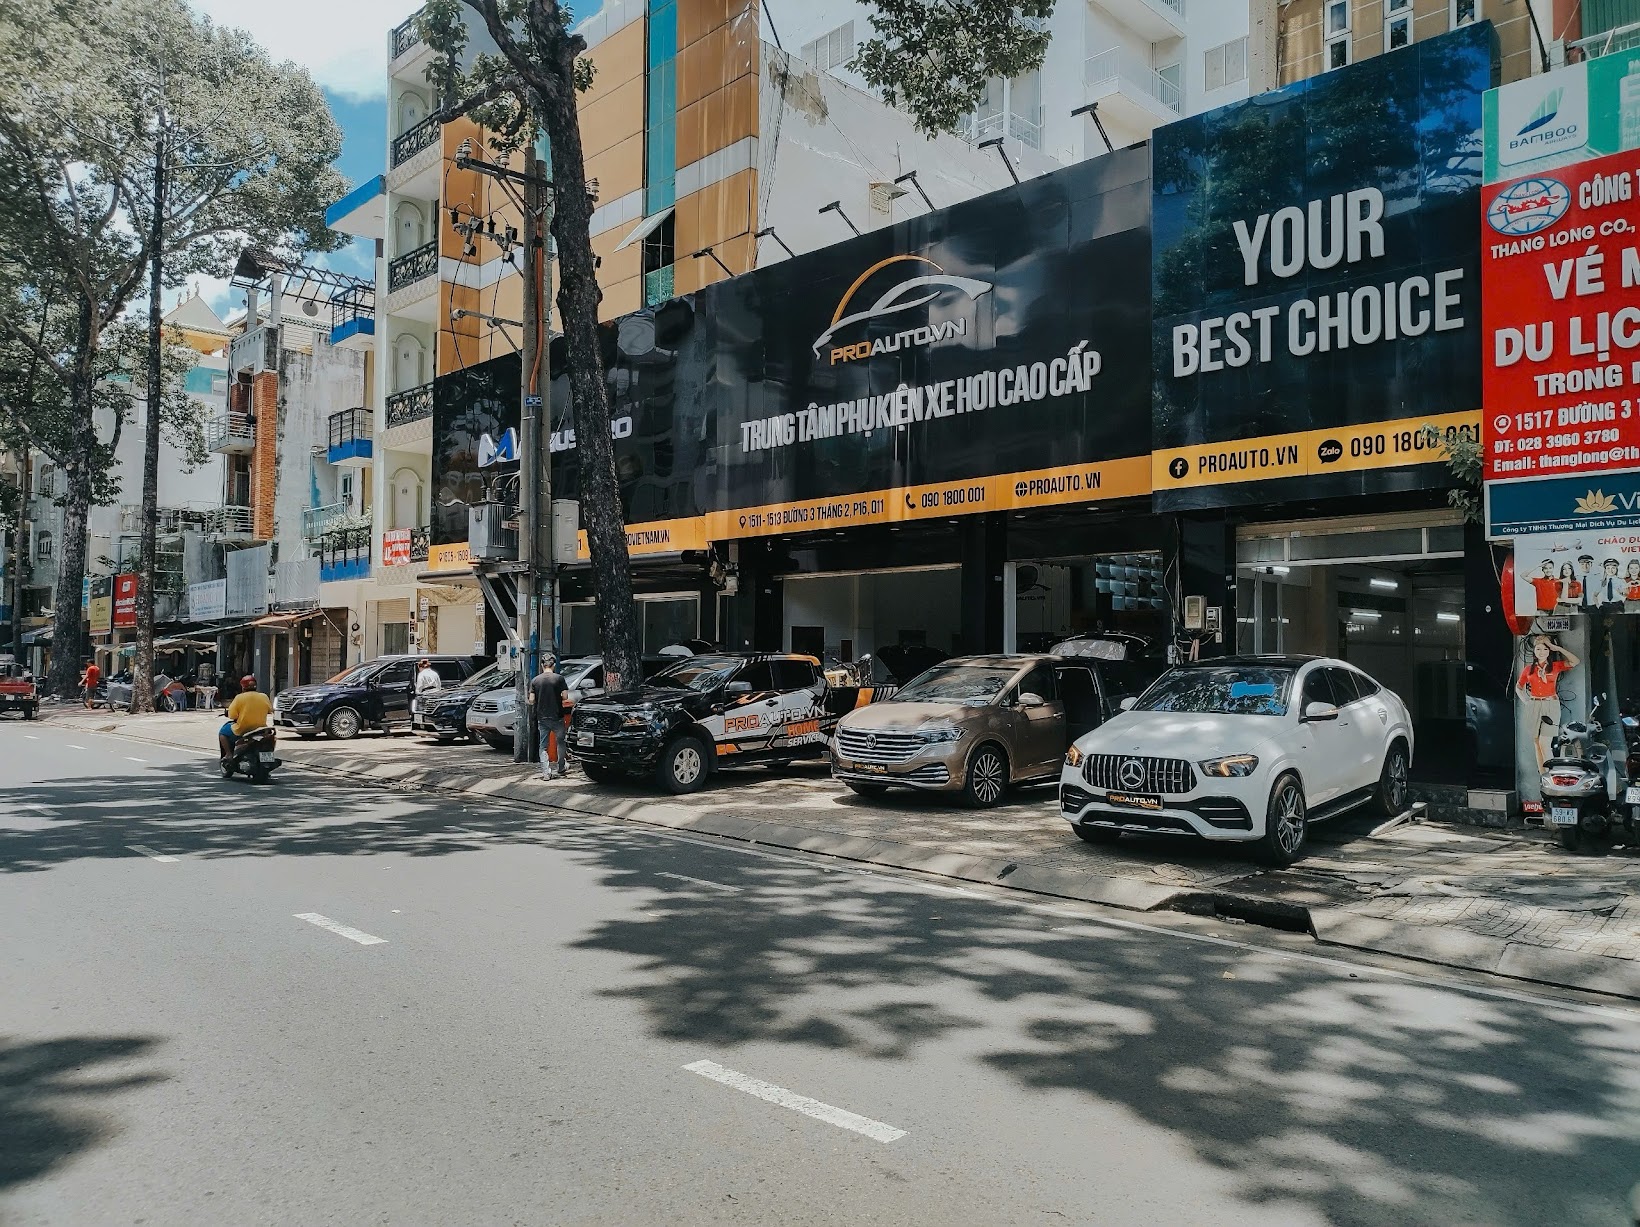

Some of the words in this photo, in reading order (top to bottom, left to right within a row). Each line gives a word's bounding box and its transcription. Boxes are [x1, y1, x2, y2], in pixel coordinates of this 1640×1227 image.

[1579, 171, 1632, 210] CÔNG
[1232, 186, 1386, 286] YOUR
[1491, 236, 1545, 259] THANG
[1549, 225, 1595, 248] LONG
[1543, 244, 1604, 300] VÉ
[1172, 305, 1280, 378] BEST
[1288, 268, 1465, 357] CHOICE
[830, 317, 967, 366] PROAUTO.VN
[1495, 321, 1554, 367] DU
[740, 413, 796, 453] TRUNG
[796, 402, 836, 443] TÂM
[836, 396, 876, 438] PHỤ
[876, 383, 924, 431] KIỆN
[924, 380, 956, 420] XE
[956, 370, 997, 414] HƠI
[998, 361, 1048, 406] CAO
[1049, 339, 1102, 397] CẤP
[1534, 364, 1623, 397] TRONG
[1515, 410, 1553, 431] 1517
[1557, 400, 1616, 427] ĐƯỜNG
[1621, 399, 1632, 419] 3
[1320, 446, 1341, 457] Zalo
[1350, 434, 1386, 457] 090
[1494, 440, 1514, 454] ĐT:
[1517, 437, 1542, 452] 028
[1546, 432, 1580, 449] 3960
[1584, 428, 1620, 445] 3780
[1198, 444, 1298, 475] PROAUTO.VN
[1493, 456, 1536, 472] Email:
[810, 507, 815, 521] 3
[816, 502, 843, 521] THÁNG
[921, 491, 939, 508] 090
[942, 488, 965, 506] 1800
[967, 486, 985, 503] 001
[725, 704, 826, 734] PROAUTO.VN
[787, 720, 820, 738] HOME
[787, 731, 821, 748] SERVICE
[1109, 794, 1158, 805] PROAUTO.VN
